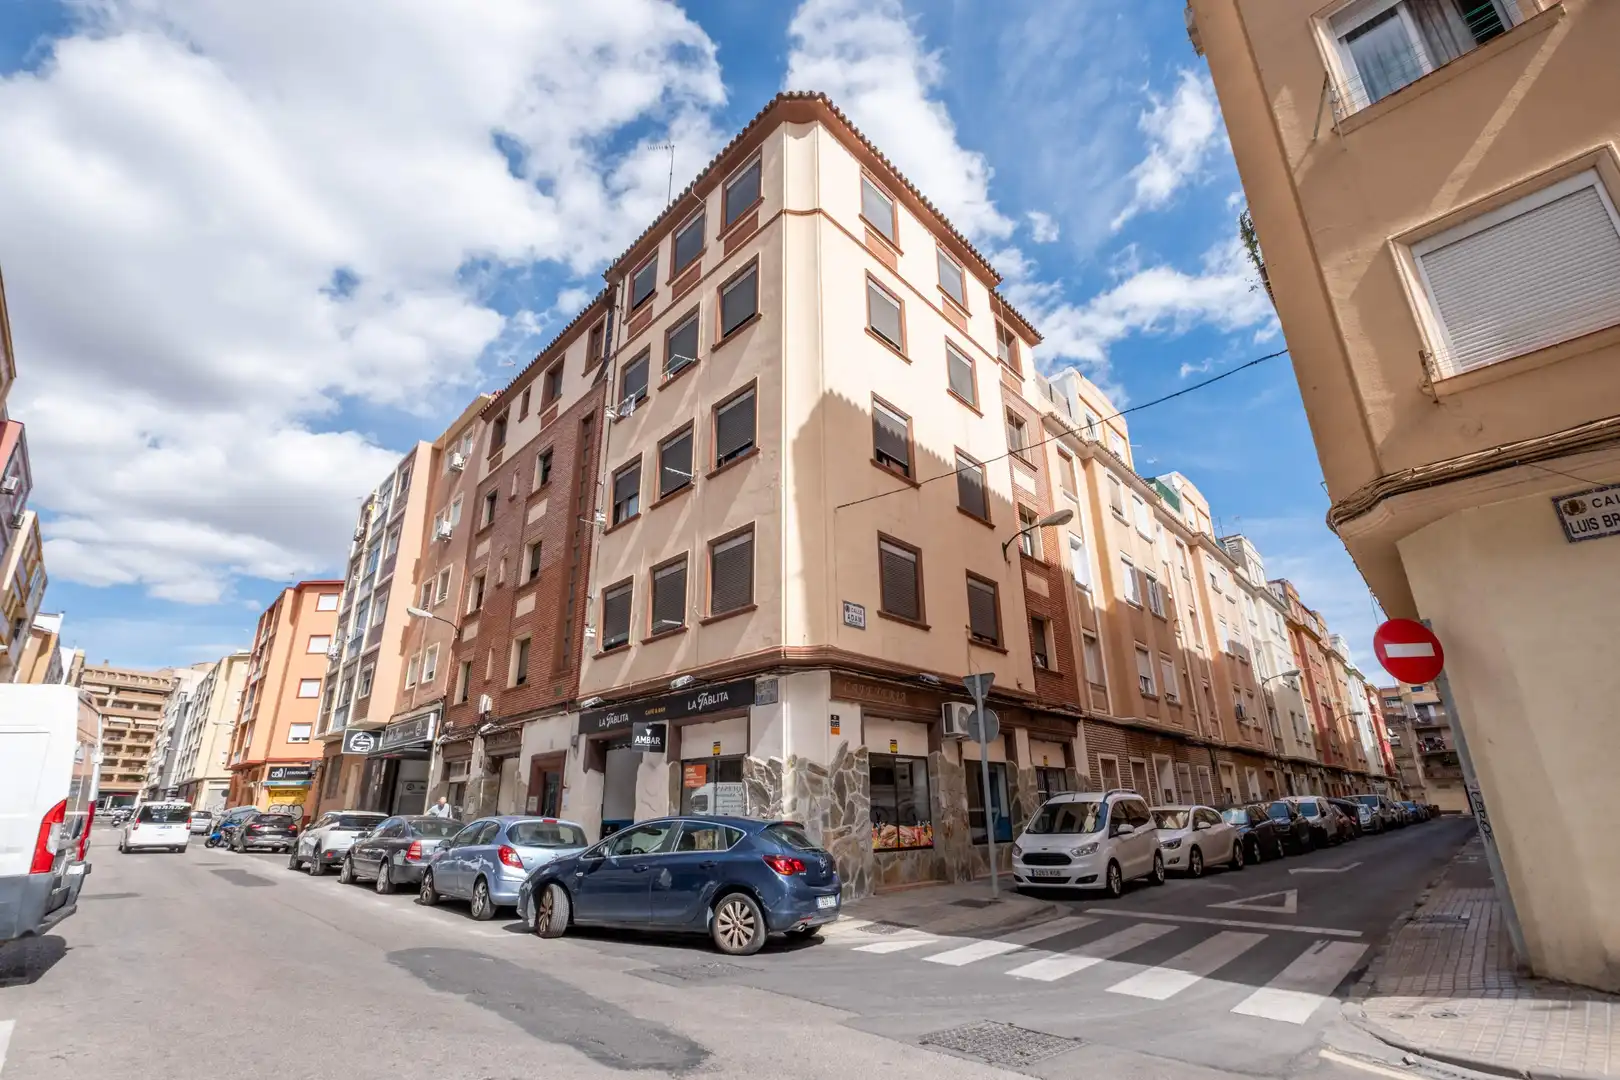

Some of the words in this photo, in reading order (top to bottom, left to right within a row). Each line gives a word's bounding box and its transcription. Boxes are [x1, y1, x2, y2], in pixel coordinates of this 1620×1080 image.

[1569, 517, 1599, 534] LUIS
[687, 700, 697, 710] LA
[697, 692, 729, 711] TABLITA
[599, 718, 606, 727] LA
[606, 713, 629, 728] TABLITA
[635, 735, 661, 745] AMBAR
